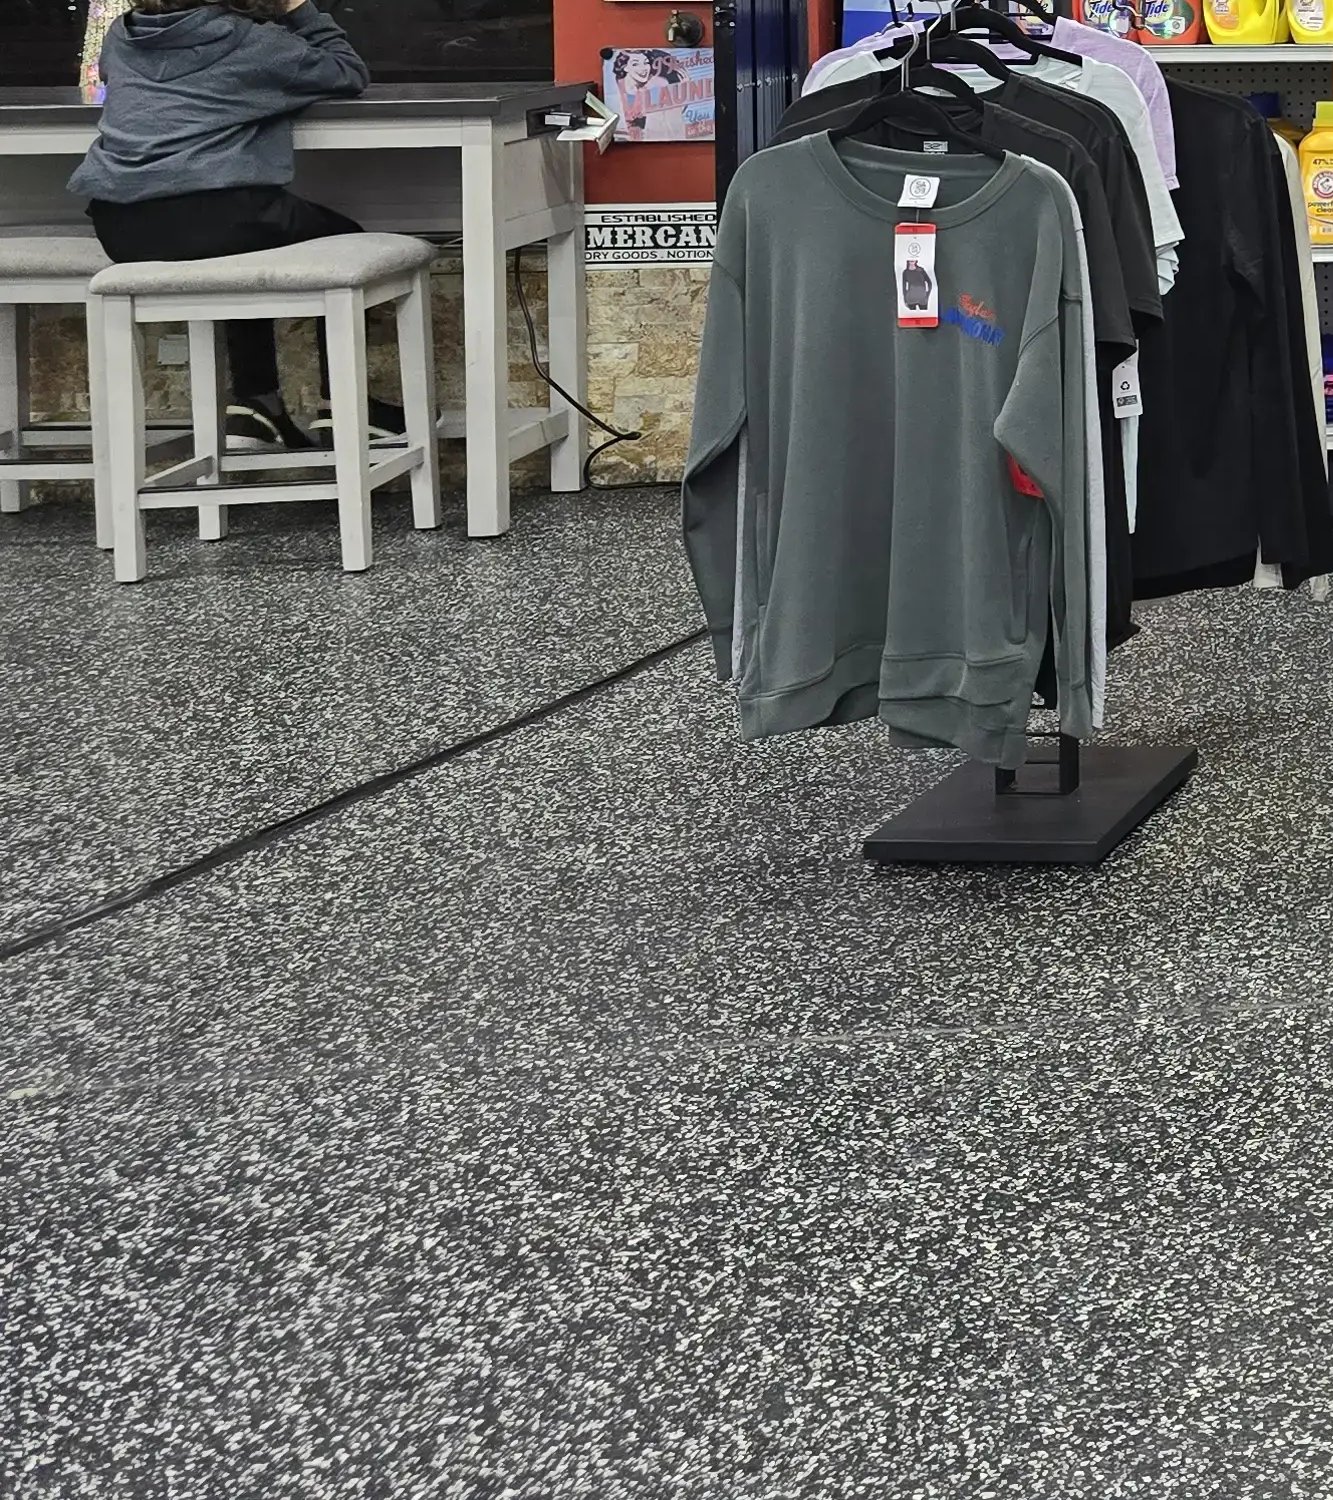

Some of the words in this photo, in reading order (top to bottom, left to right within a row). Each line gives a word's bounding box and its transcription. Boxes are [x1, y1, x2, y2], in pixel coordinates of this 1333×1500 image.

[686, 109, 710, 123] You
[601, 214, 716, 223] ESTABLISHED
[587, 226, 716, 248] MERCAN
[612, 251, 657, 260] GOODS
